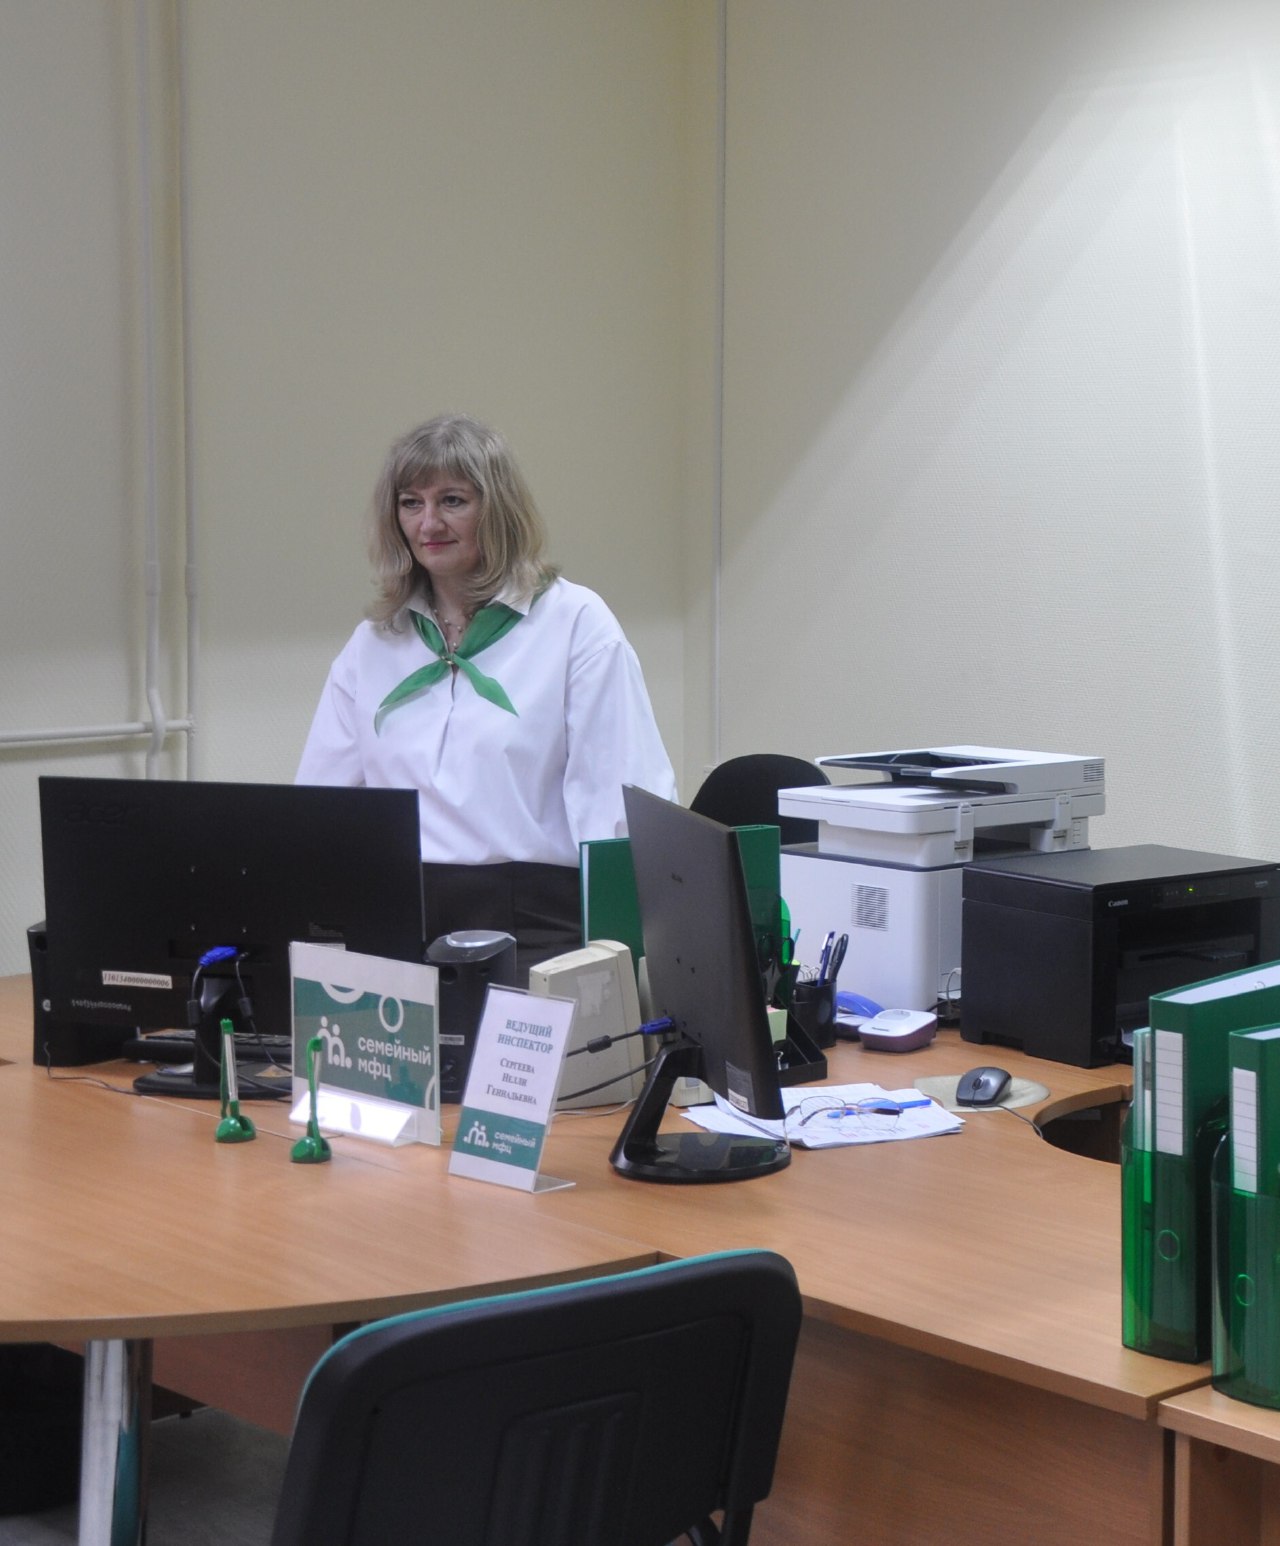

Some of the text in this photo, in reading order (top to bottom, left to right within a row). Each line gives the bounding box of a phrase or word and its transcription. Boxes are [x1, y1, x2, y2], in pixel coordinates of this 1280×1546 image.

[1108, 899, 1129, 908] Canon
[506, 1019, 553, 1038] ВЕДУЩИЙ
[358, 1036, 432, 1066] семейный
[497, 1034, 553, 1054] ИНСПЕКТОР
[358, 1057, 392, 1081] мфц
[492, 1142, 512, 1155] мфц
[494, 1131, 537, 1148] семейный
